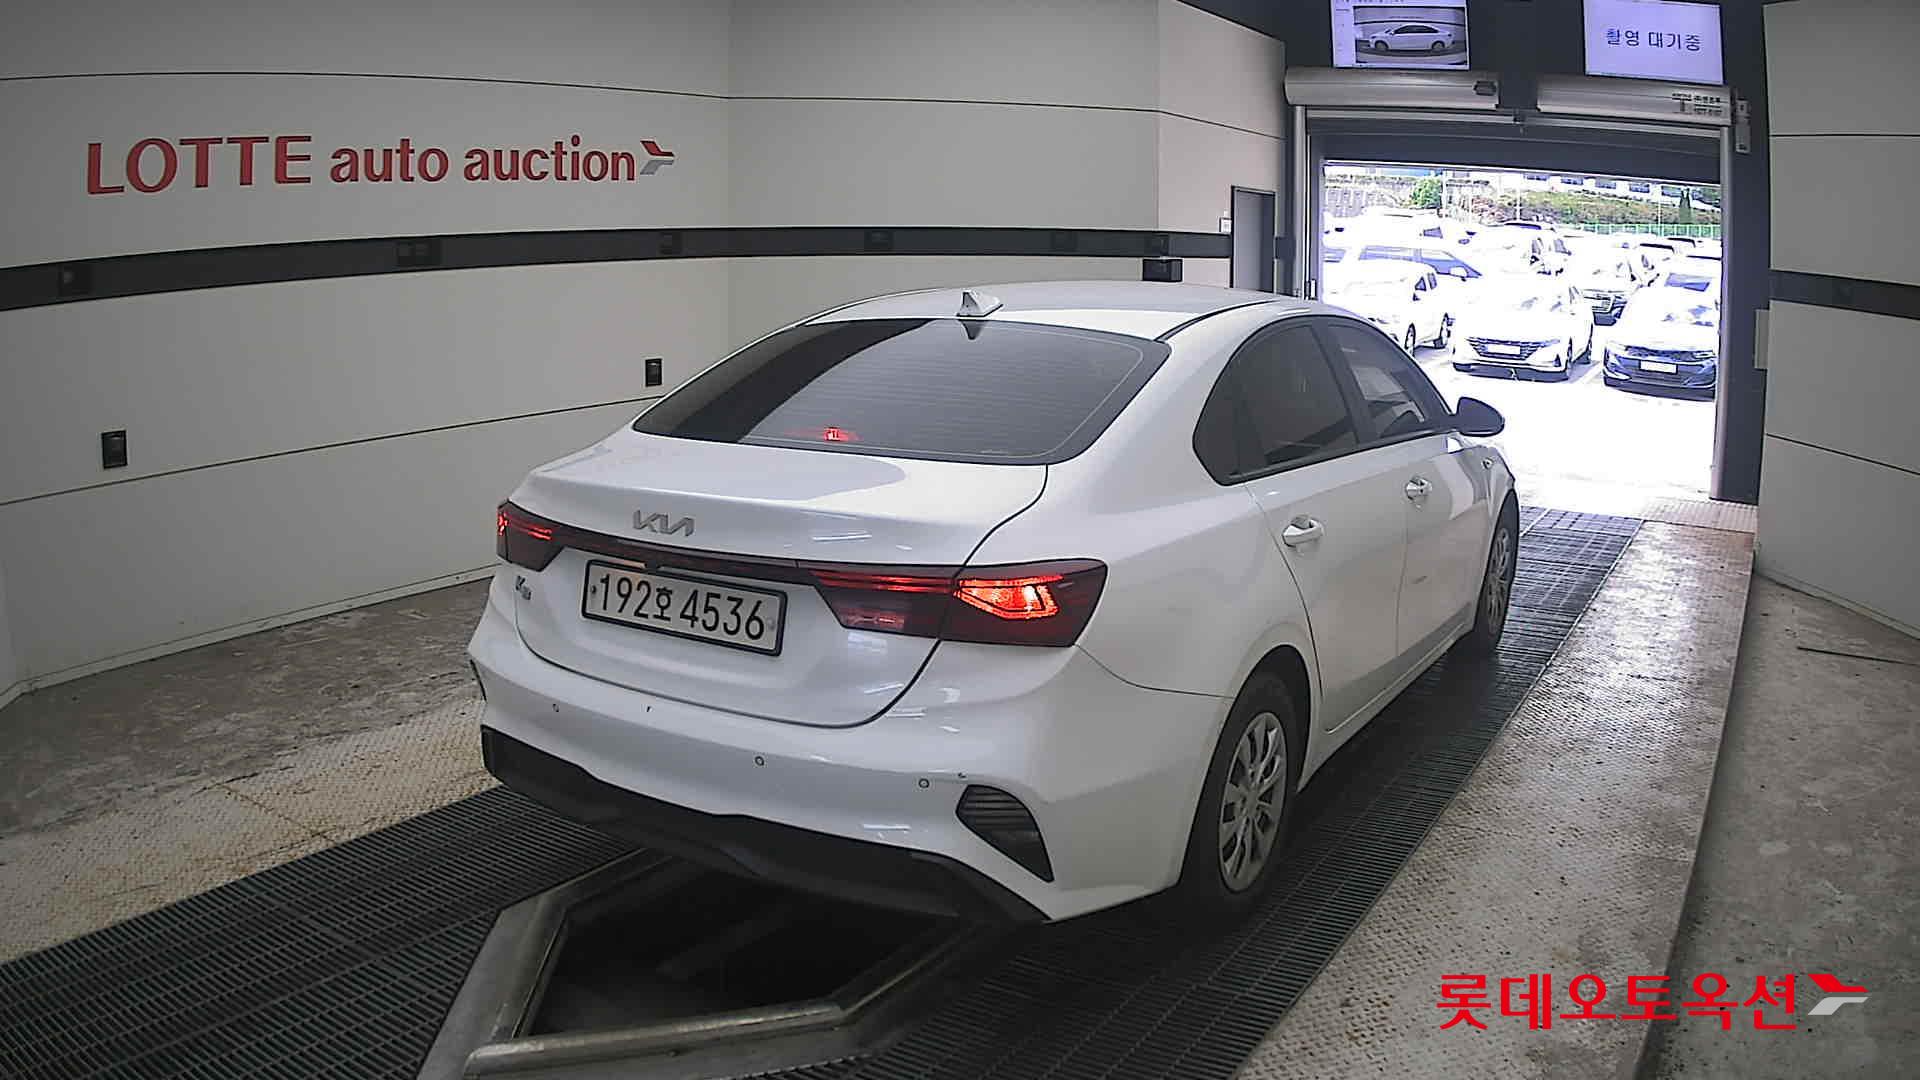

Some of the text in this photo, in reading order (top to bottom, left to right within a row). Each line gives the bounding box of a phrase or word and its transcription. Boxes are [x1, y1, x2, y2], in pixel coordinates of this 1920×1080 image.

[1648, 31, 1702, 52] 대기중
[87, 134, 637, 195] LOTTE auto auction
